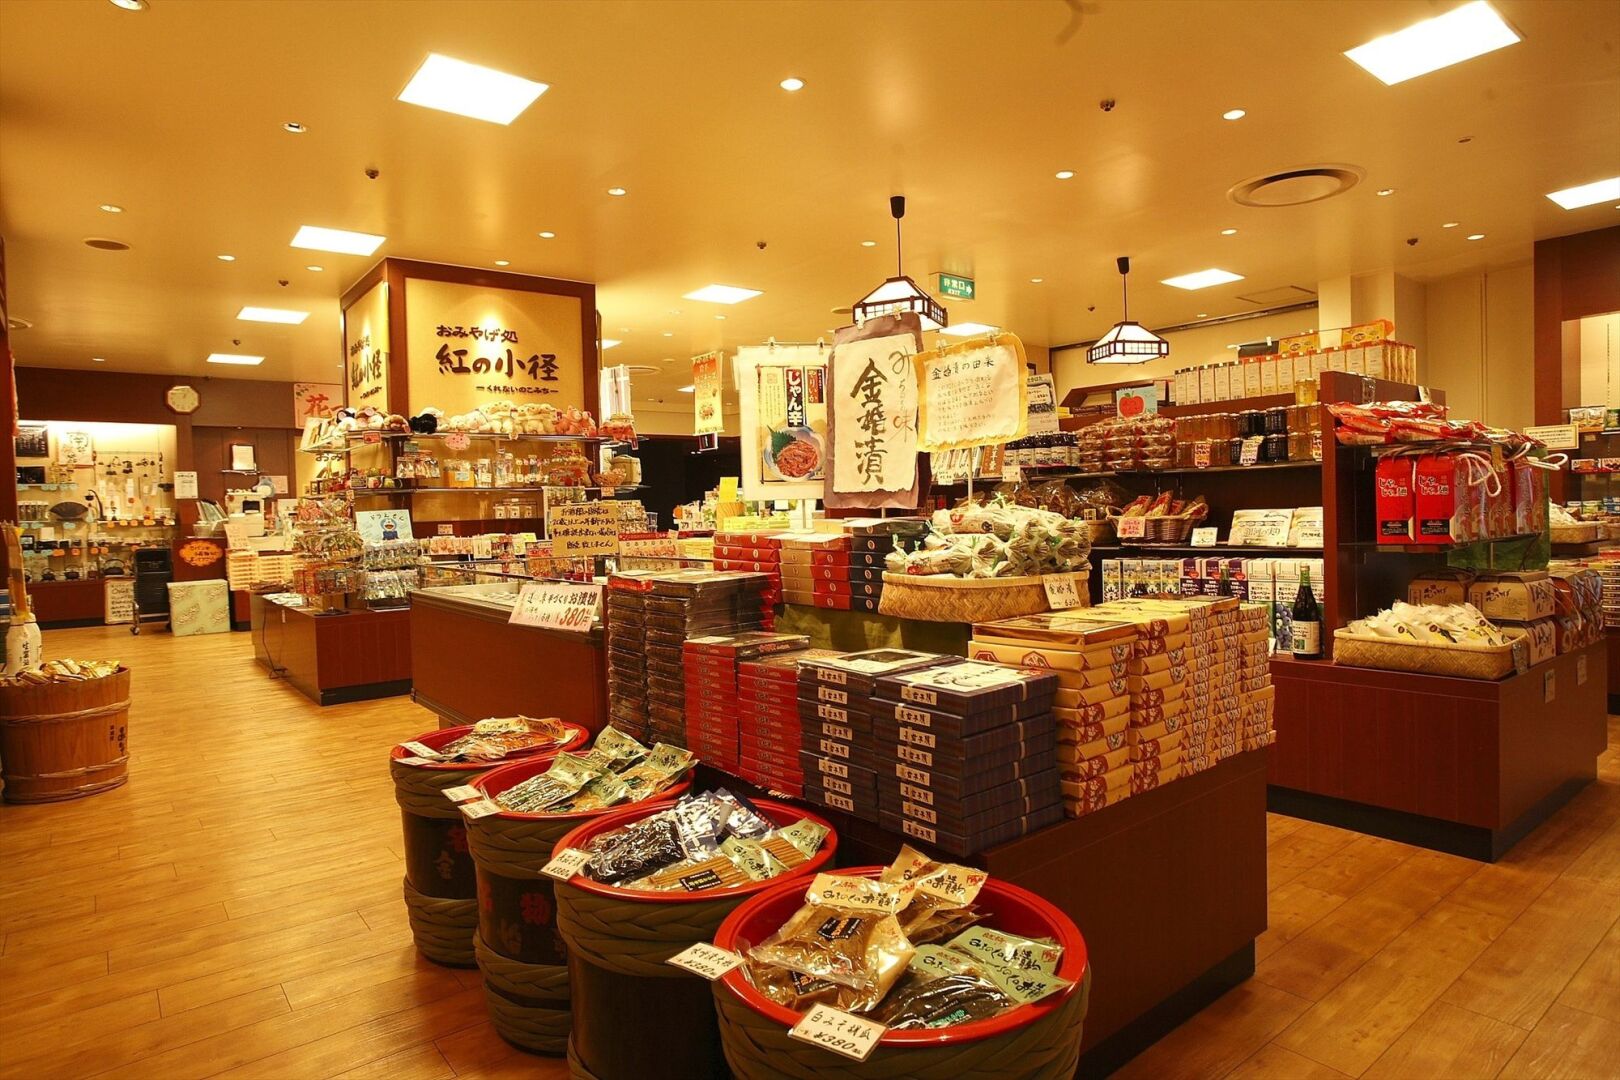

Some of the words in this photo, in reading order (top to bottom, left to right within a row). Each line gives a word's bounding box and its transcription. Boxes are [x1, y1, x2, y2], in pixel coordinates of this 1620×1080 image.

[436, 324, 518, 344] おみやげ処
[435, 343, 560, 382] 紅の小径
[787, 370, 802, 427] じゃん辛
[850, 357, 888, 485] 金婚漬
[823, 889, 901, 908] みちのくのお漬物
[811, 1010, 872, 1040] 白みそ胡瓜
[813, 1031, 856, 1050] ¥380
